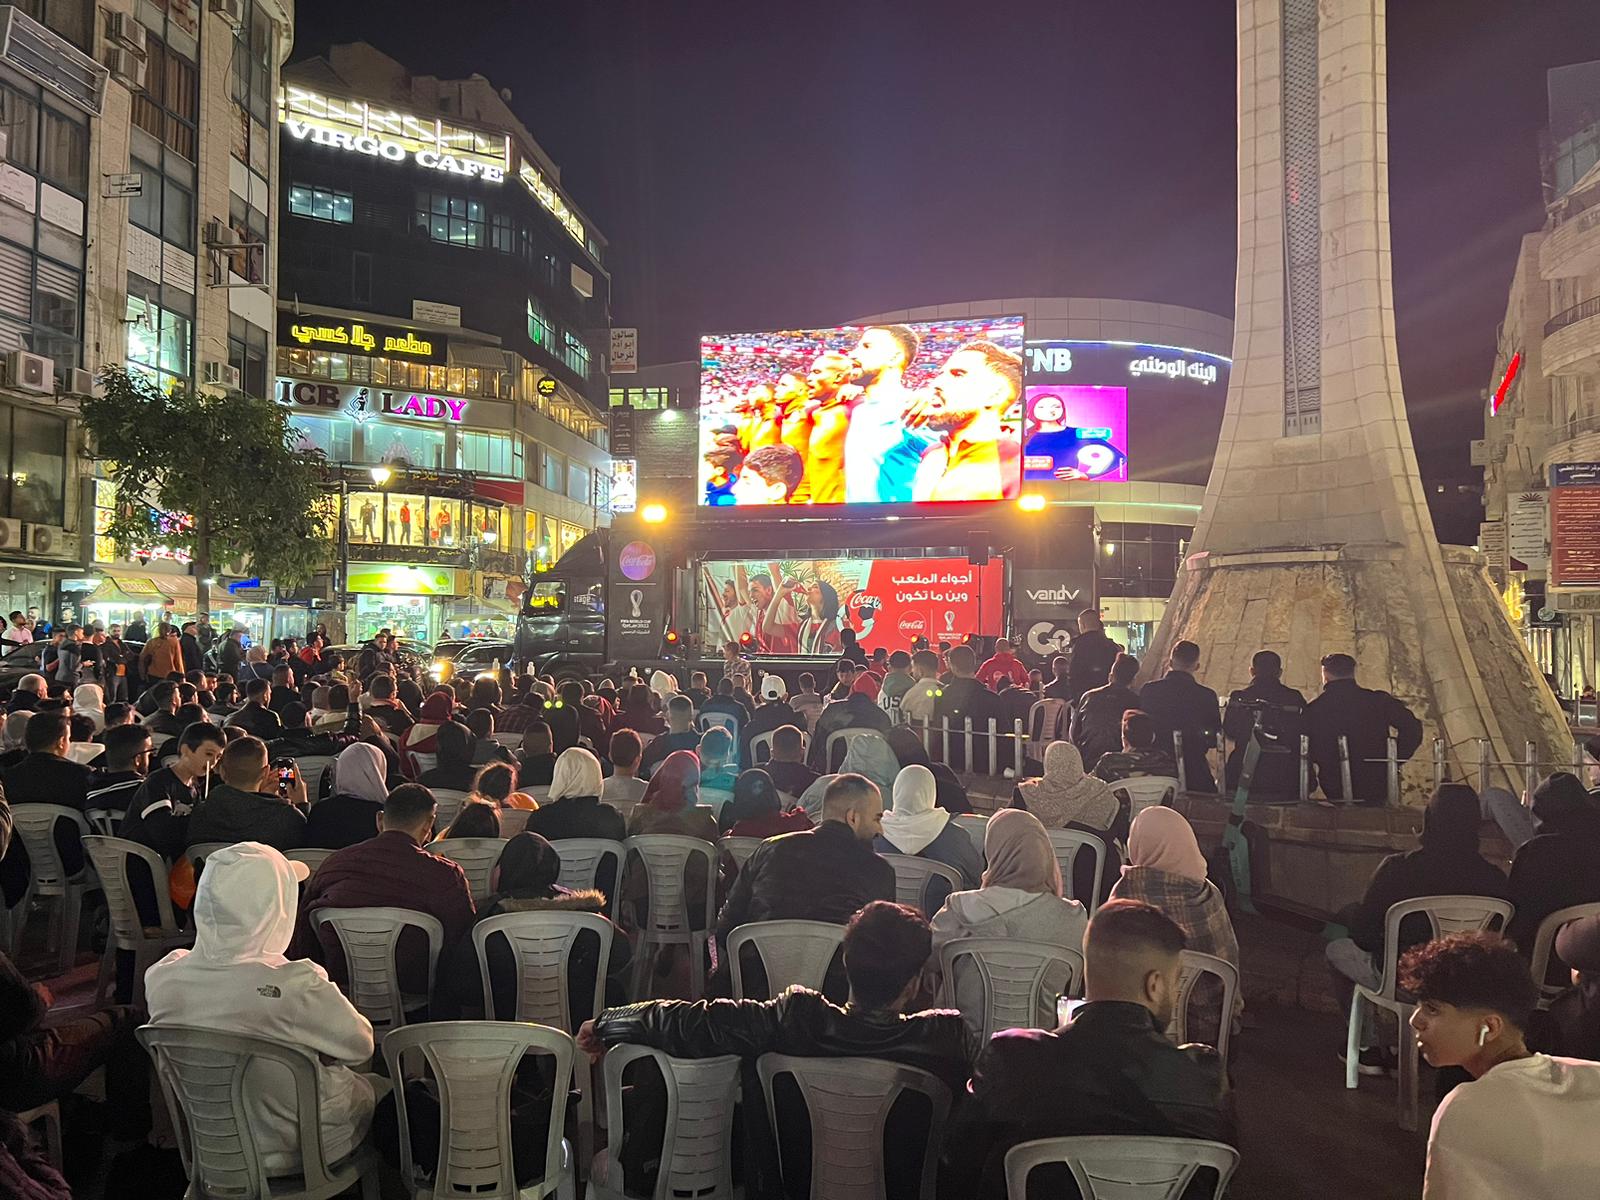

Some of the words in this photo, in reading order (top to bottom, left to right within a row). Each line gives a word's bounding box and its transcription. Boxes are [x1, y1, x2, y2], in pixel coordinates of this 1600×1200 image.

[285, 119, 406, 162] VIRGO
[415, 150, 504, 183] CAFE
[384, 333, 432, 355] مطعم
[1129, 356, 1186, 379] الوطني
[1187, 361, 1217, 385] البنك
[276, 379, 341, 409] ICE
[381, 392, 468, 421] LADY
[891, 572, 938, 586] الملعب
[940, 569, 972, 585] أجواء
[895, 590, 929, 603] تكون
[930, 590, 944, 602] ما
[945, 589, 969, 602] وين
